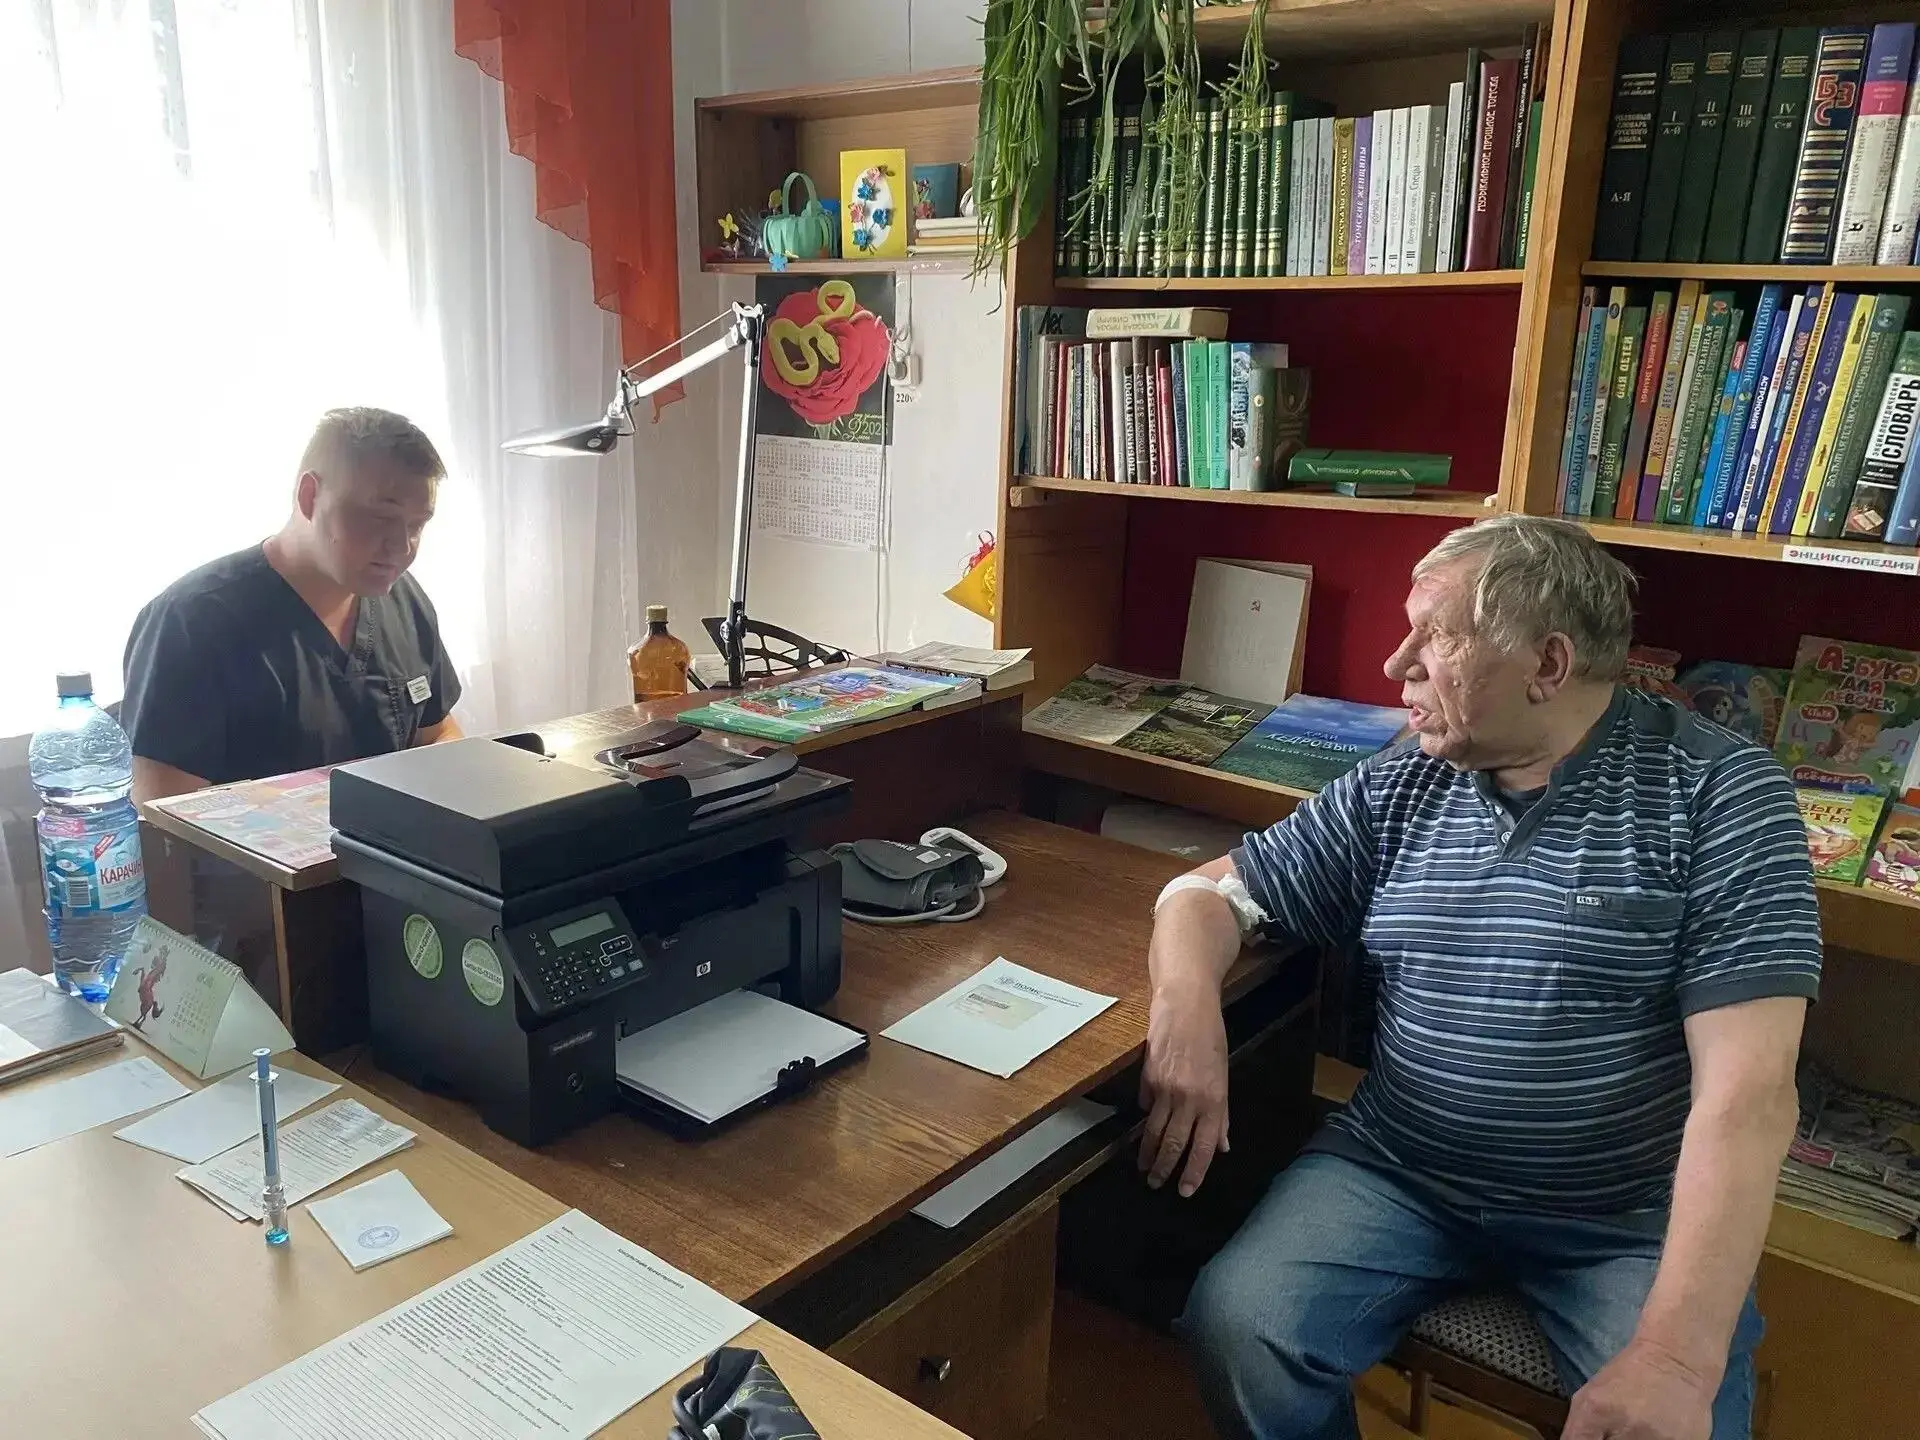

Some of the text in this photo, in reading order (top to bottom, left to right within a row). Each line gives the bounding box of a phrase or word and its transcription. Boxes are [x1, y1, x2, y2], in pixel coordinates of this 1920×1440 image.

[1477, 76, 1500, 212] МУЗЫКАЛЬНОЕ ПРОШЛОЕ ТОМСКА
[1515, 122, 1523, 148] ТОМСКИЕ
[1340, 148, 1348, 187] ТОМСКЕ
[1354, 146, 1367, 244] ТОМСКИЕ ЖЕНЩИНЫ
[1337, 198, 1346, 246] РАССКАЗЫ
[1616, 336, 1634, 399] ДЛЯ ДЕТЕЙ
[1786, 358, 1800, 390] ФАКТОВ
[1124, 374, 1136, 476] ЛЮБИМЫЙ ГОРОД
[1147, 374, 1158, 476] СТРЕЖЕВОЙ
[1590, 403, 1605, 450] ПРИРОДА
[1673, 325, 1714, 482] БОЛЬШАЯ ИЛЛЮСТРИРОВАННАЯ
[1714, 296, 1774, 509] БОЛЬШАЯ ШКОЛЬНАЯ ЭНЦИКЛОПЕДИЯ
[1749, 375, 1769, 430] АСТРОНОМИЯ
[1872, 377, 1900, 456] ЭНЦИКЛОПЕДИЧЕСКИЙ
[1882, 379, 1920, 460] СЛОВАРЬ
[1569, 434, 1587, 496] БОЛЬШАЯ
[1605, 443, 1618, 482] ЗВЕРИ
[1789, 550, 1914, 570] ЭНЦИКЛОПЕДИЯ
[1264, 732, 1358, 753] КЕДРОВЫЙ
